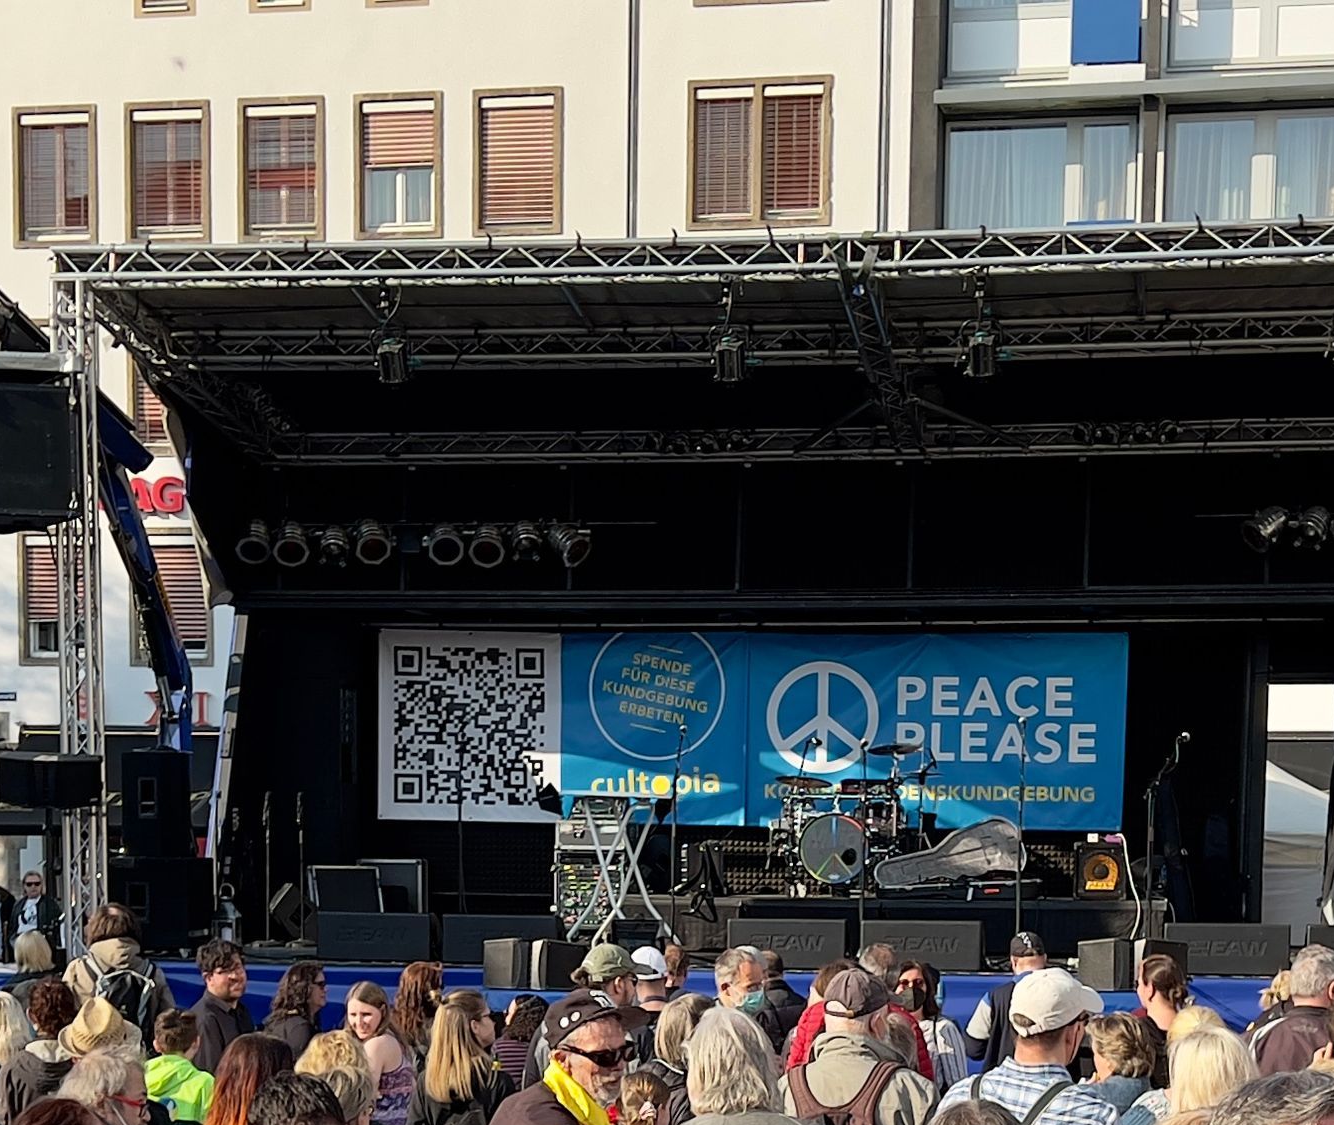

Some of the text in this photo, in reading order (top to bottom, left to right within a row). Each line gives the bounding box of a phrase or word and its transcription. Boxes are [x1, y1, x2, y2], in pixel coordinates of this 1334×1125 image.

[632, 652, 691, 676] SPENDE
[621, 667, 696, 693] FÜR DIESE
[602, 679, 708, 714] KUNDGEBUNG
[896, 676, 1074, 717] PEACE
[619, 701, 685, 725] ERBETEN
[895, 723, 1098, 764] PLEASE
